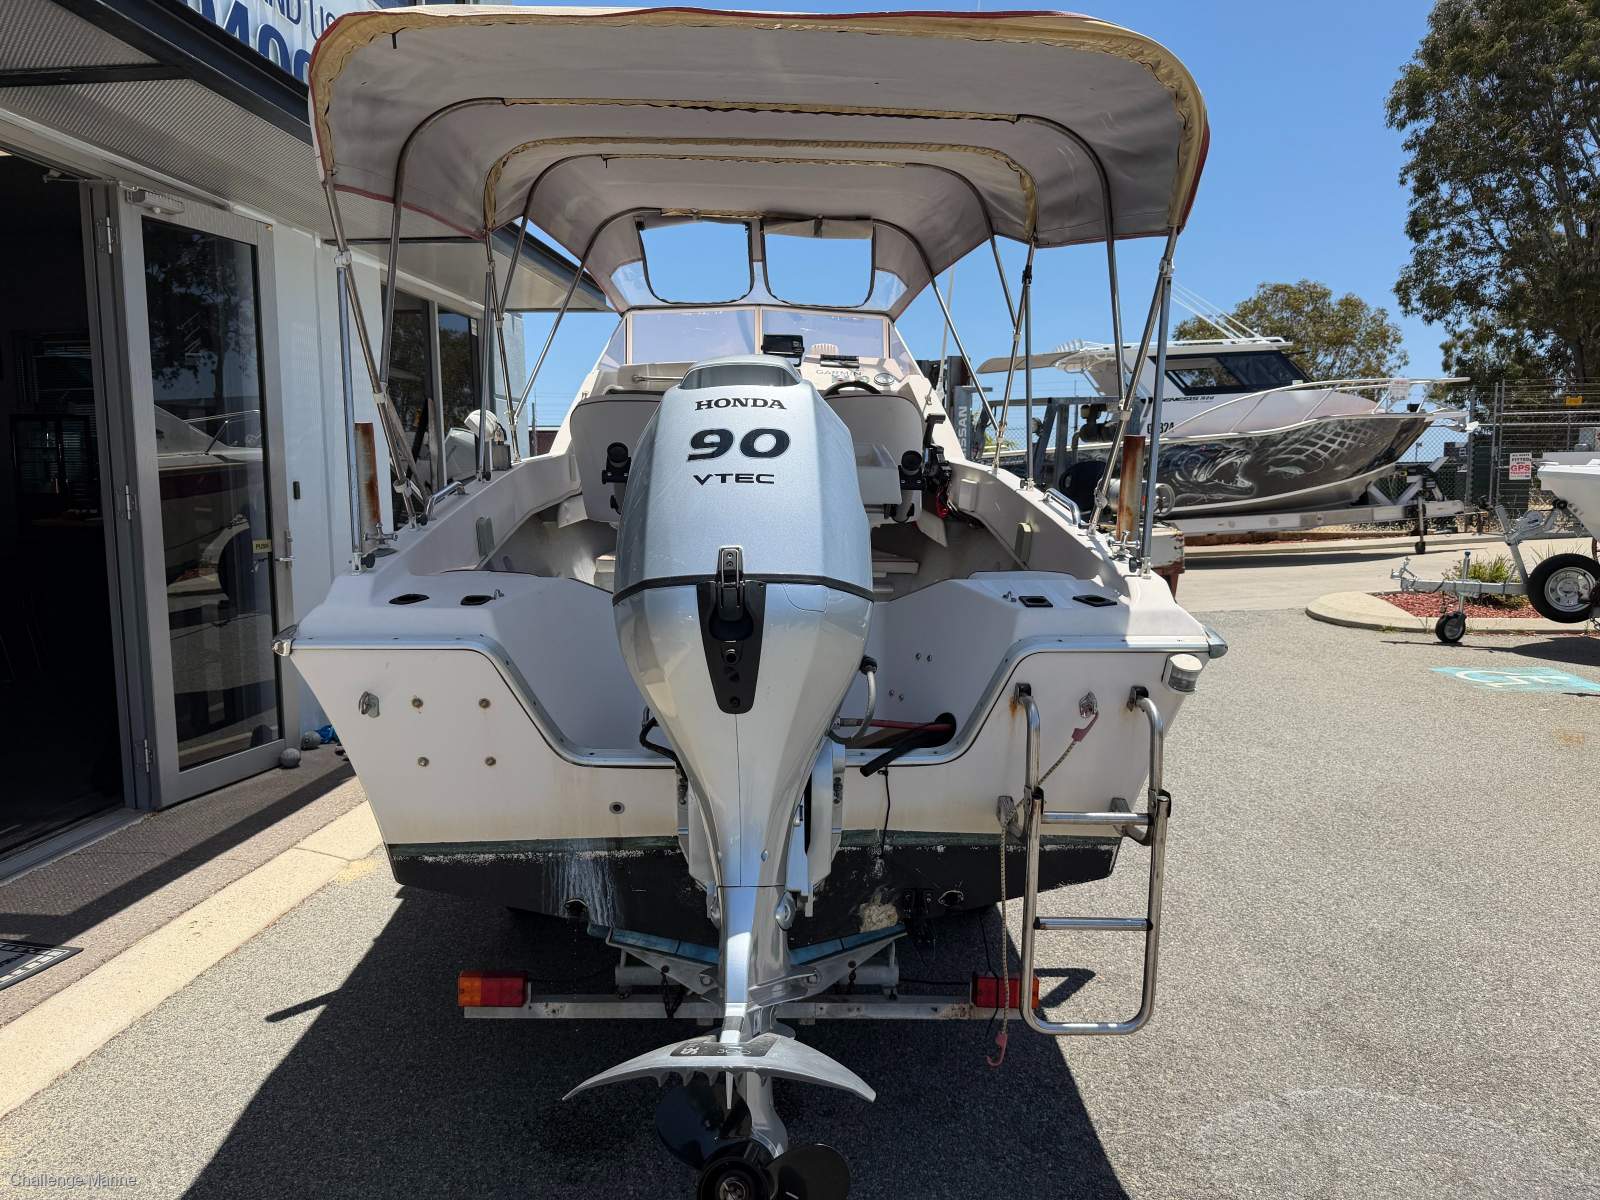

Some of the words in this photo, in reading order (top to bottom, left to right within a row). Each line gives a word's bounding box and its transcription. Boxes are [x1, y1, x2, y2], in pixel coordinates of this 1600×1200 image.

[695, 398, 787, 411] HONDA
[687, 428, 791, 461] 90
[1510, 464, 1531, 472] GPS
[693, 473, 774, 485] VTEC
